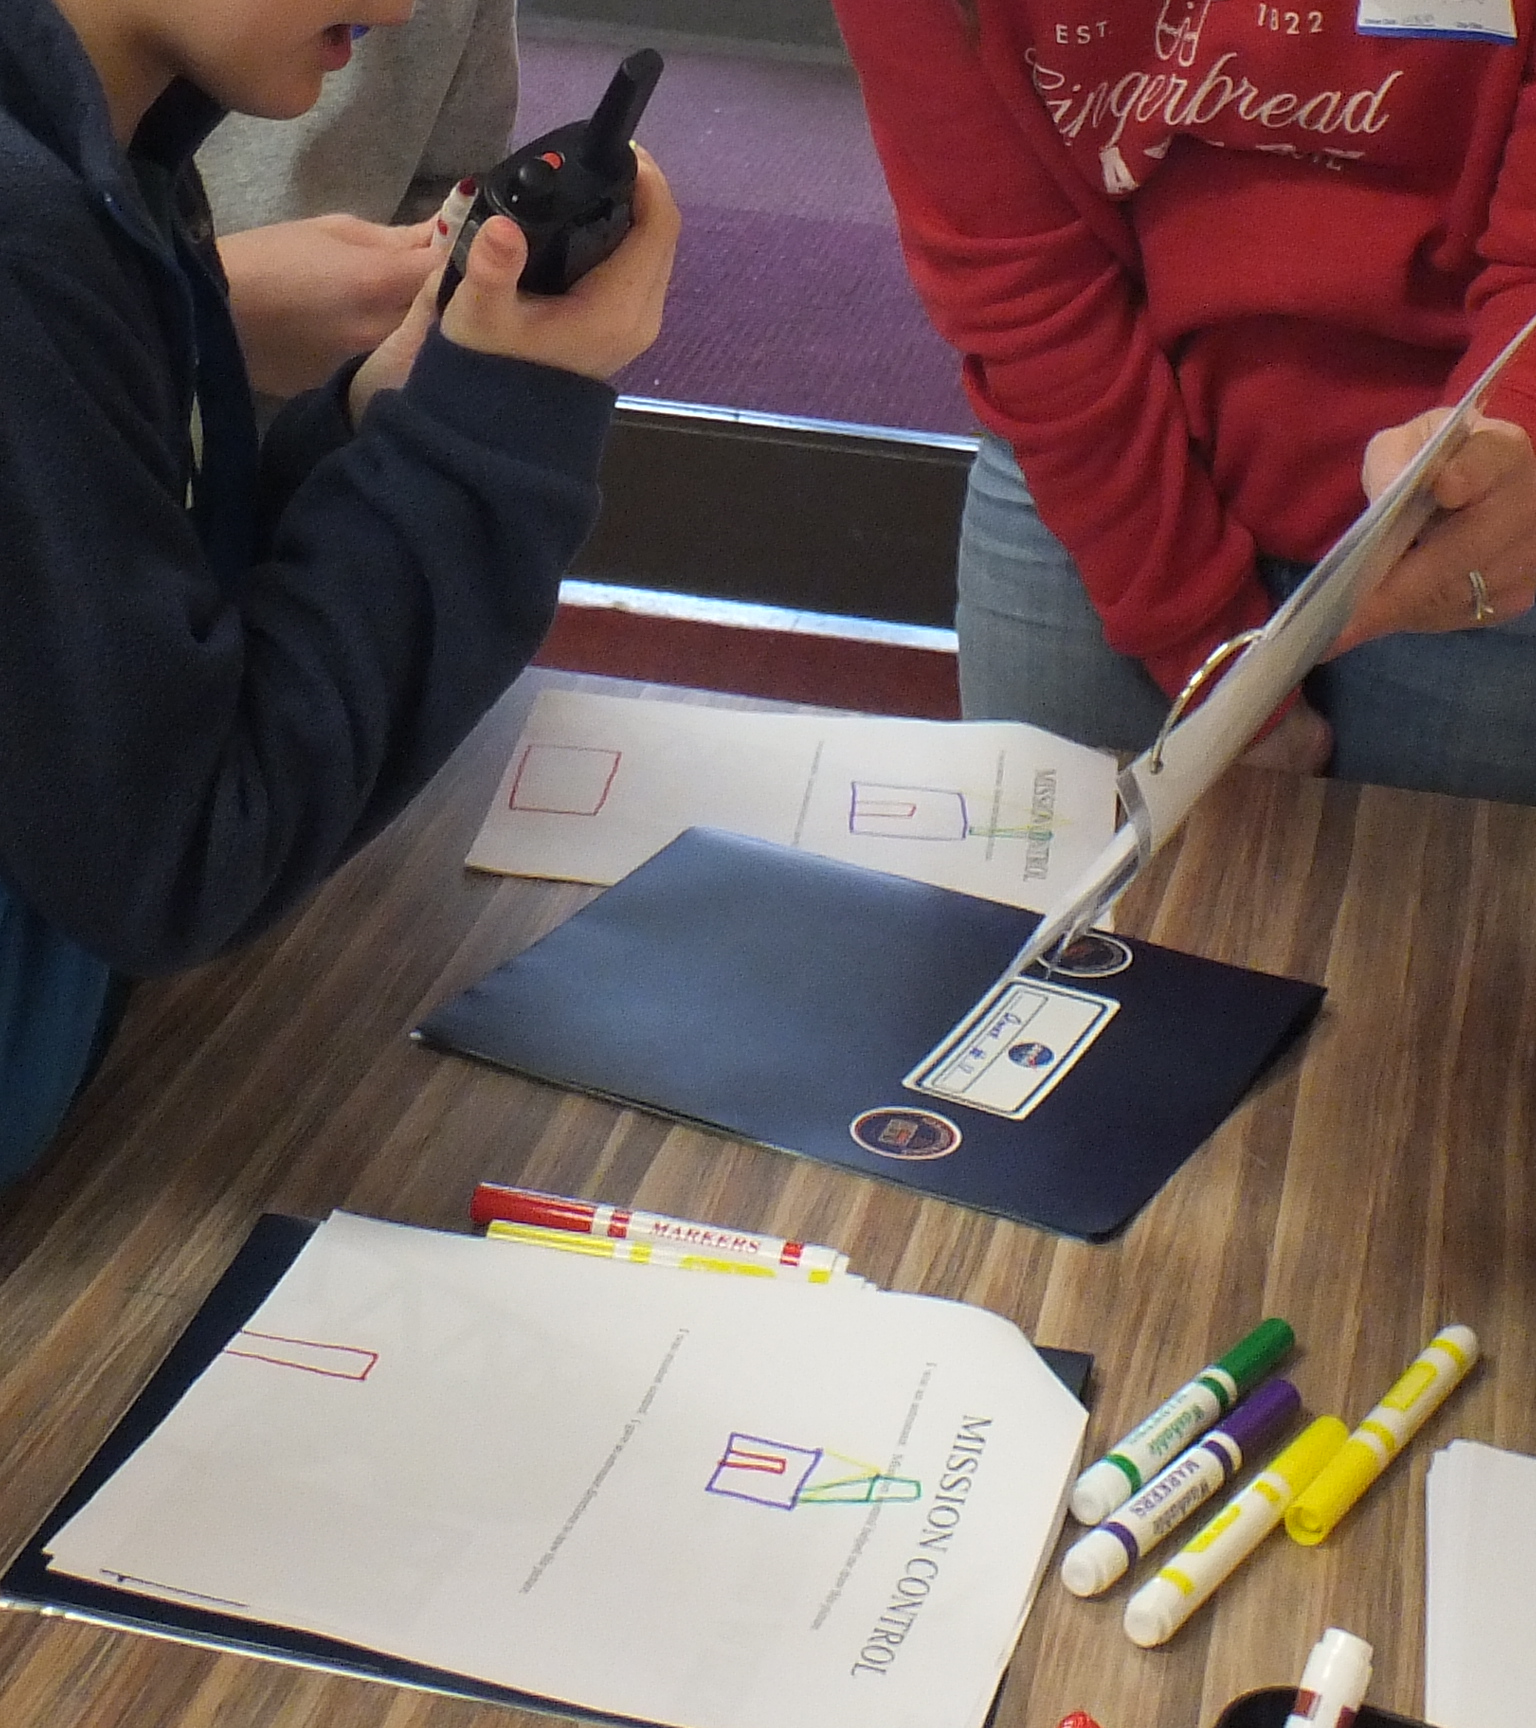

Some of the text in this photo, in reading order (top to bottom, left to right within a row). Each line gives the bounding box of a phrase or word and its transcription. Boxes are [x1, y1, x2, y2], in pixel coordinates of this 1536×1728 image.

[650, 1222, 761, 1254] MARKERS
[919, 1414, 993, 1553] MISSION
[1130, 1459, 1200, 1517] MARKERS
[851, 1557, 939, 1676] CONTROL
